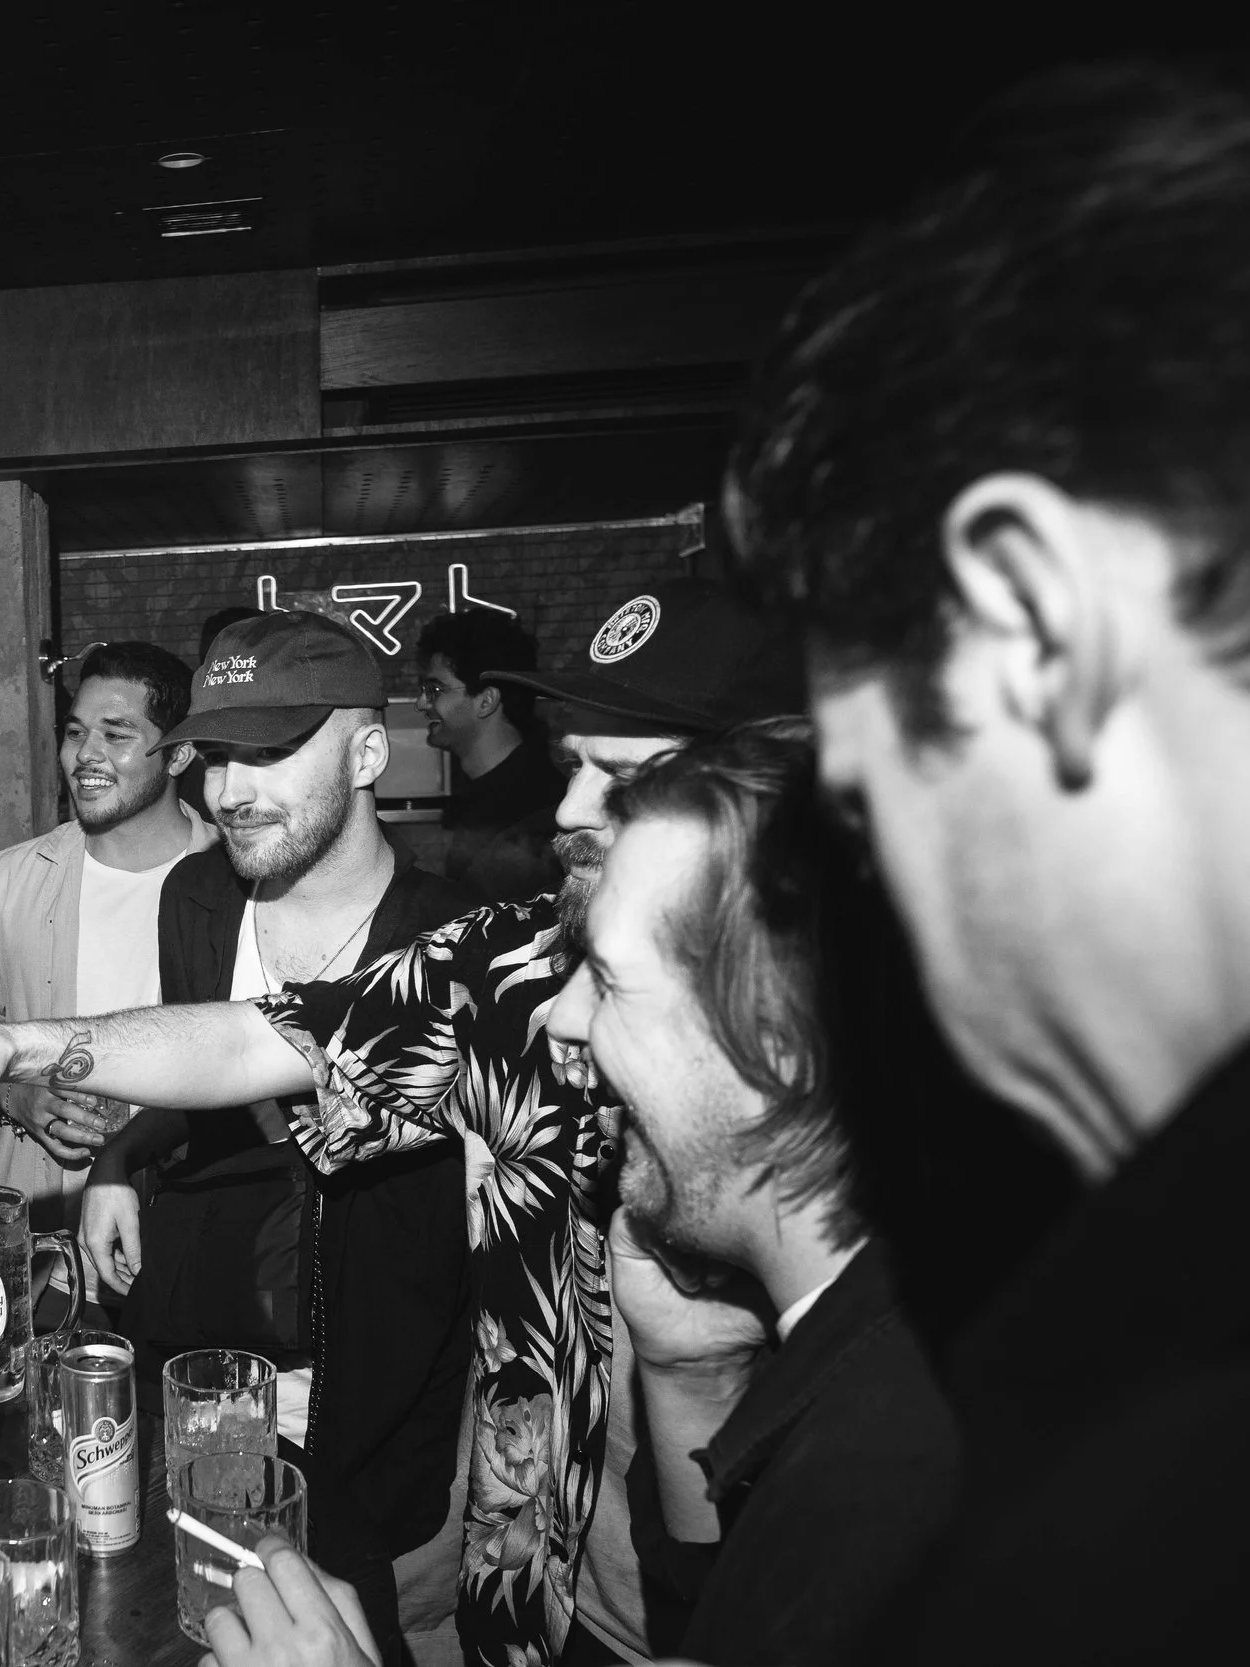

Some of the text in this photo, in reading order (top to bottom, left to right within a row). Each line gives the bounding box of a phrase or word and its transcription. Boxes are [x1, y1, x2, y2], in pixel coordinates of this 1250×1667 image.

[207, 655, 257, 674] New York
[202, 669, 254, 688] New York
